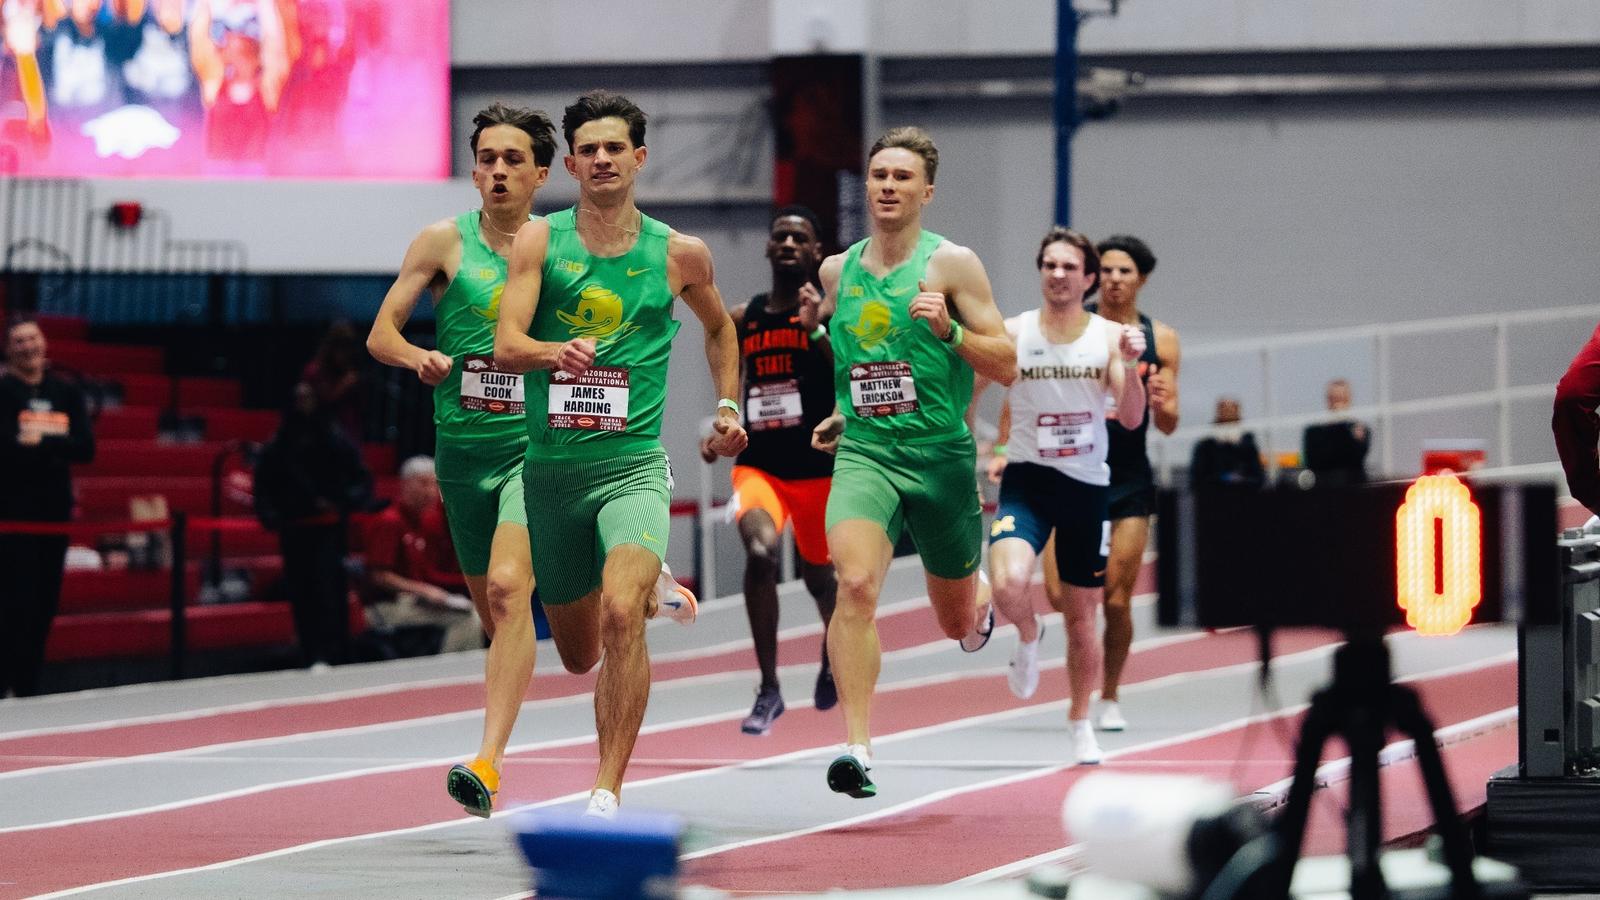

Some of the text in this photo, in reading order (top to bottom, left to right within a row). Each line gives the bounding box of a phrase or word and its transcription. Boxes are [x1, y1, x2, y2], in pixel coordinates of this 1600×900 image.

[756, 353, 794, 376] STATE
[481, 373, 518, 386] ELLIOTT
[579, 376, 629, 386] INVITATIONAL
[584, 370, 622, 379] AZORBACK
[860, 379, 901, 392] MATTHEW
[484, 386, 512, 399] COOK
[571, 386, 605, 400] JAMES
[862, 391, 904, 404] ERICKSON
[564, 400, 611, 414] HARDING
[1396, 475, 1480, 636] 0
